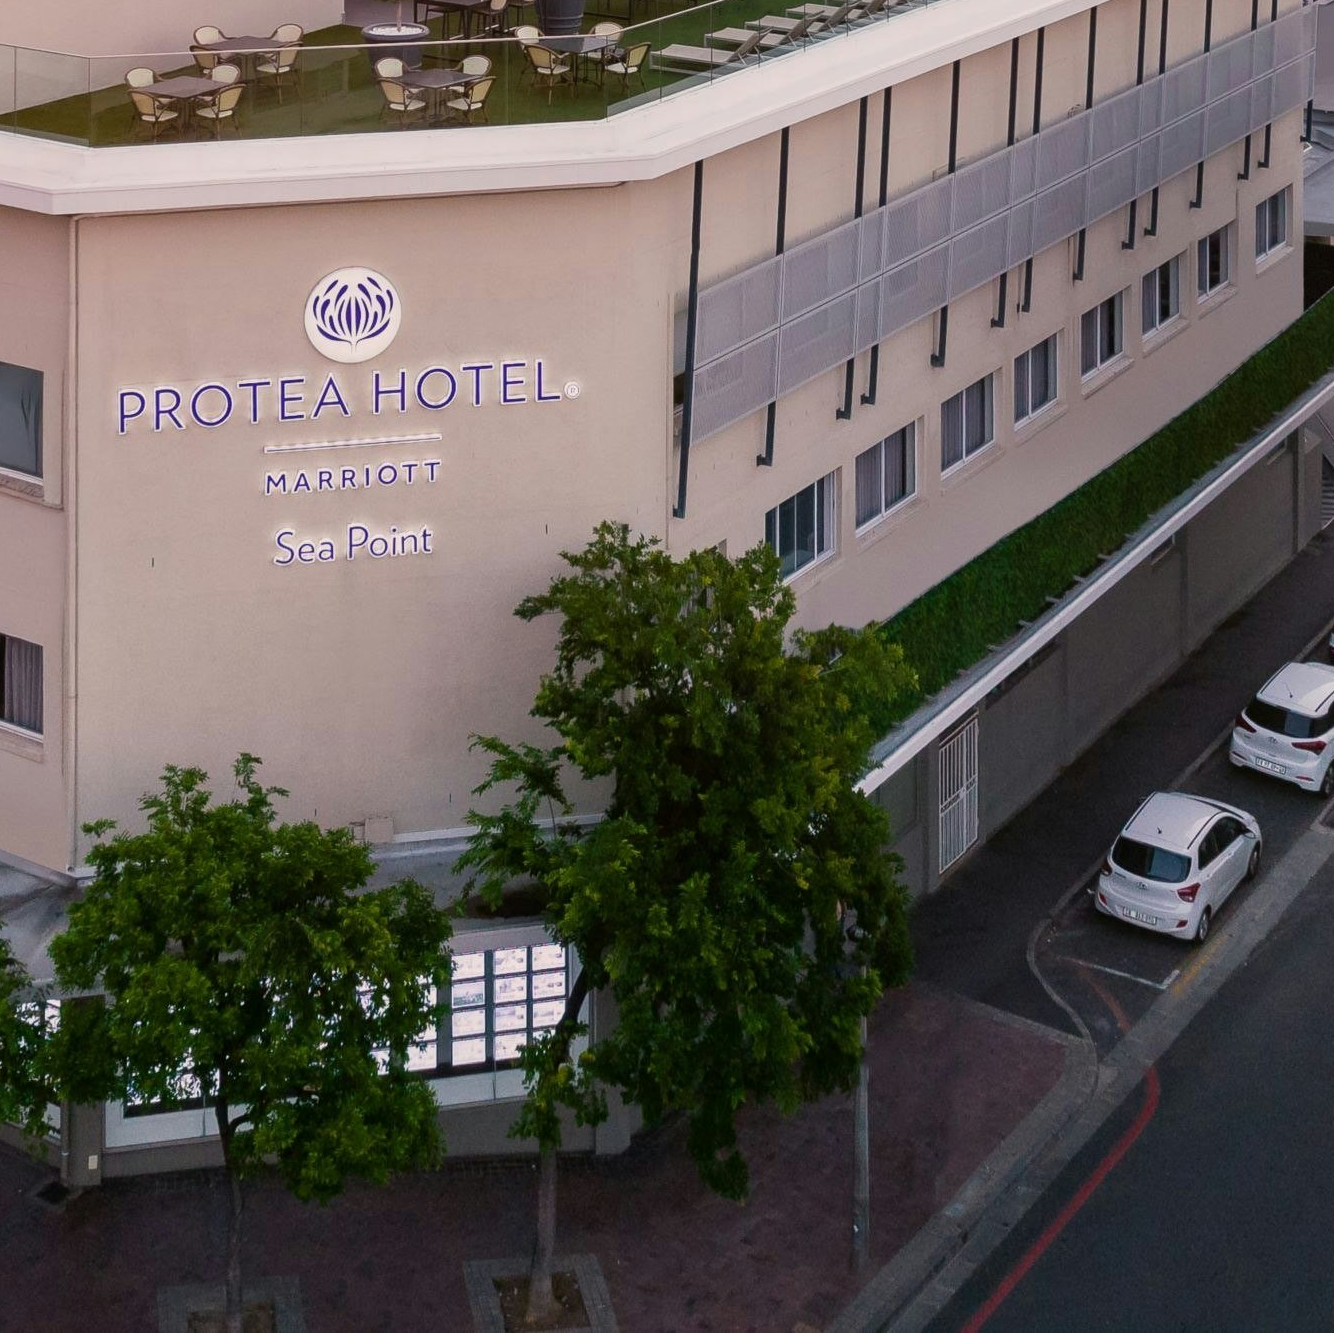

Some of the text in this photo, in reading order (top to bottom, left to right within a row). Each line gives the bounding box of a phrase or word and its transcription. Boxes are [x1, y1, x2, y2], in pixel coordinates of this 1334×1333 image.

[119, 375, 350, 433] PROTEA
[266, 461, 441, 495] MARRIOTT
[275, 526, 432, 564] Sea Point
